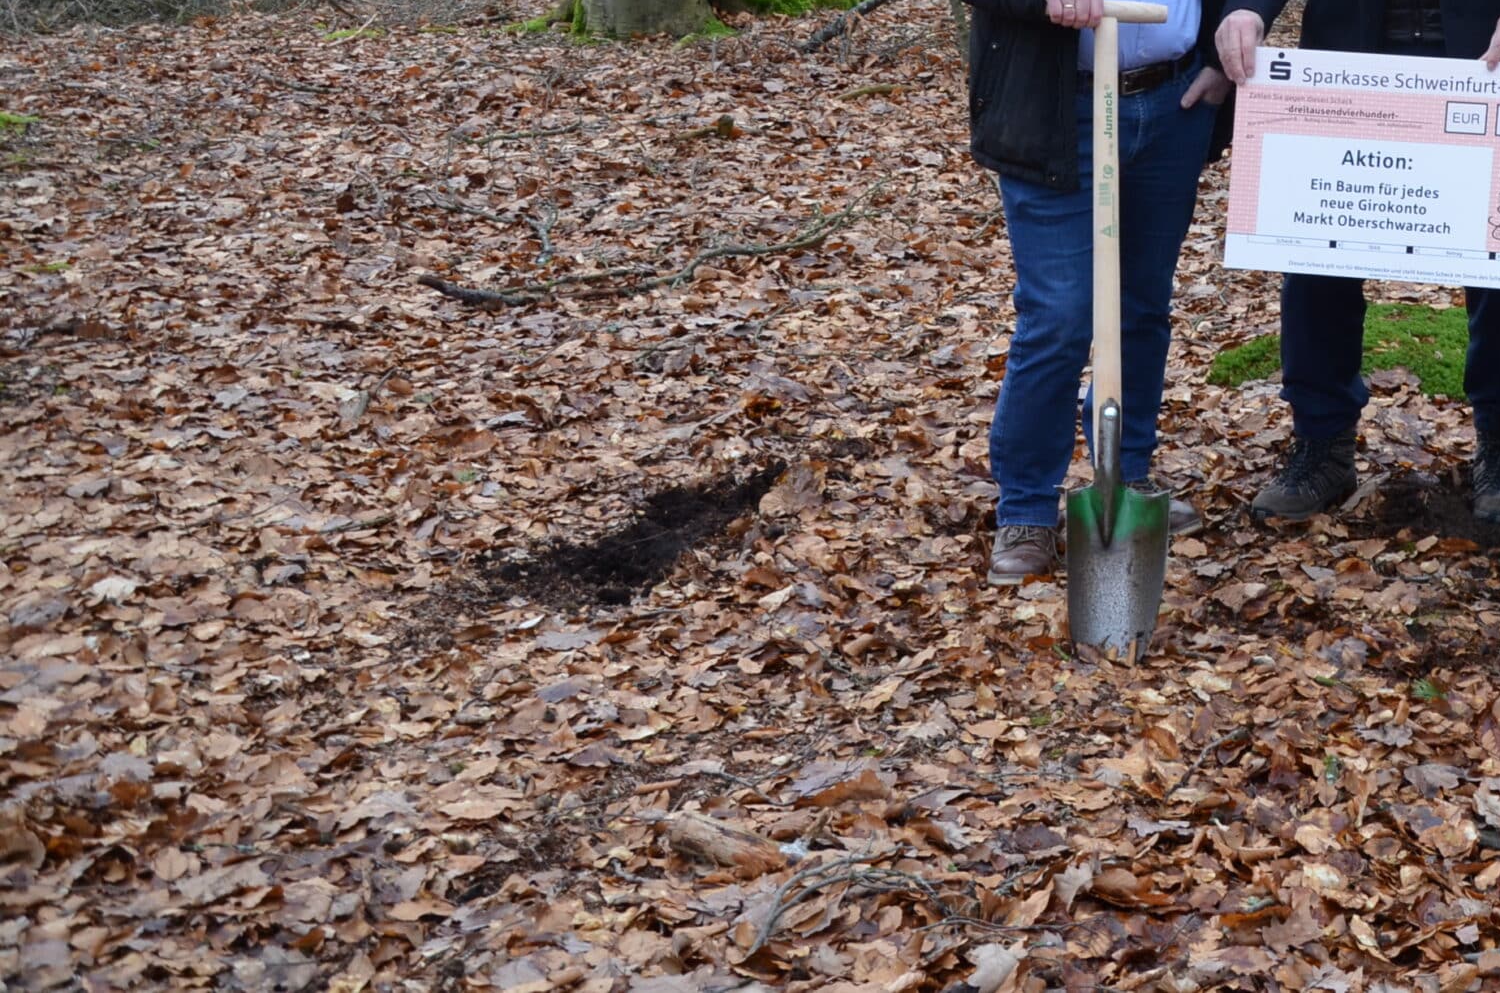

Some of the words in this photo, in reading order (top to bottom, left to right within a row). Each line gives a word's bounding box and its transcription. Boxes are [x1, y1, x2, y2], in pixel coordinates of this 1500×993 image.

[1302, 67, 1390, 87] Sparkasse
[1452, 111, 1480, 125] EUR
[1341, 149, 1414, 171] Aktion:
[1310, 178, 1332, 192] Ein
[1336, 180, 1375, 195] Baum
[1378, 182, 1398, 197] für
[1401, 184, 1440, 200] jedes
[1320, 198, 1355, 210] neue
[1358, 199, 1427, 215] Girokonto
[1293, 211, 1334, 226] Markt
[1337, 214, 1451, 234] Oberschwarzach
